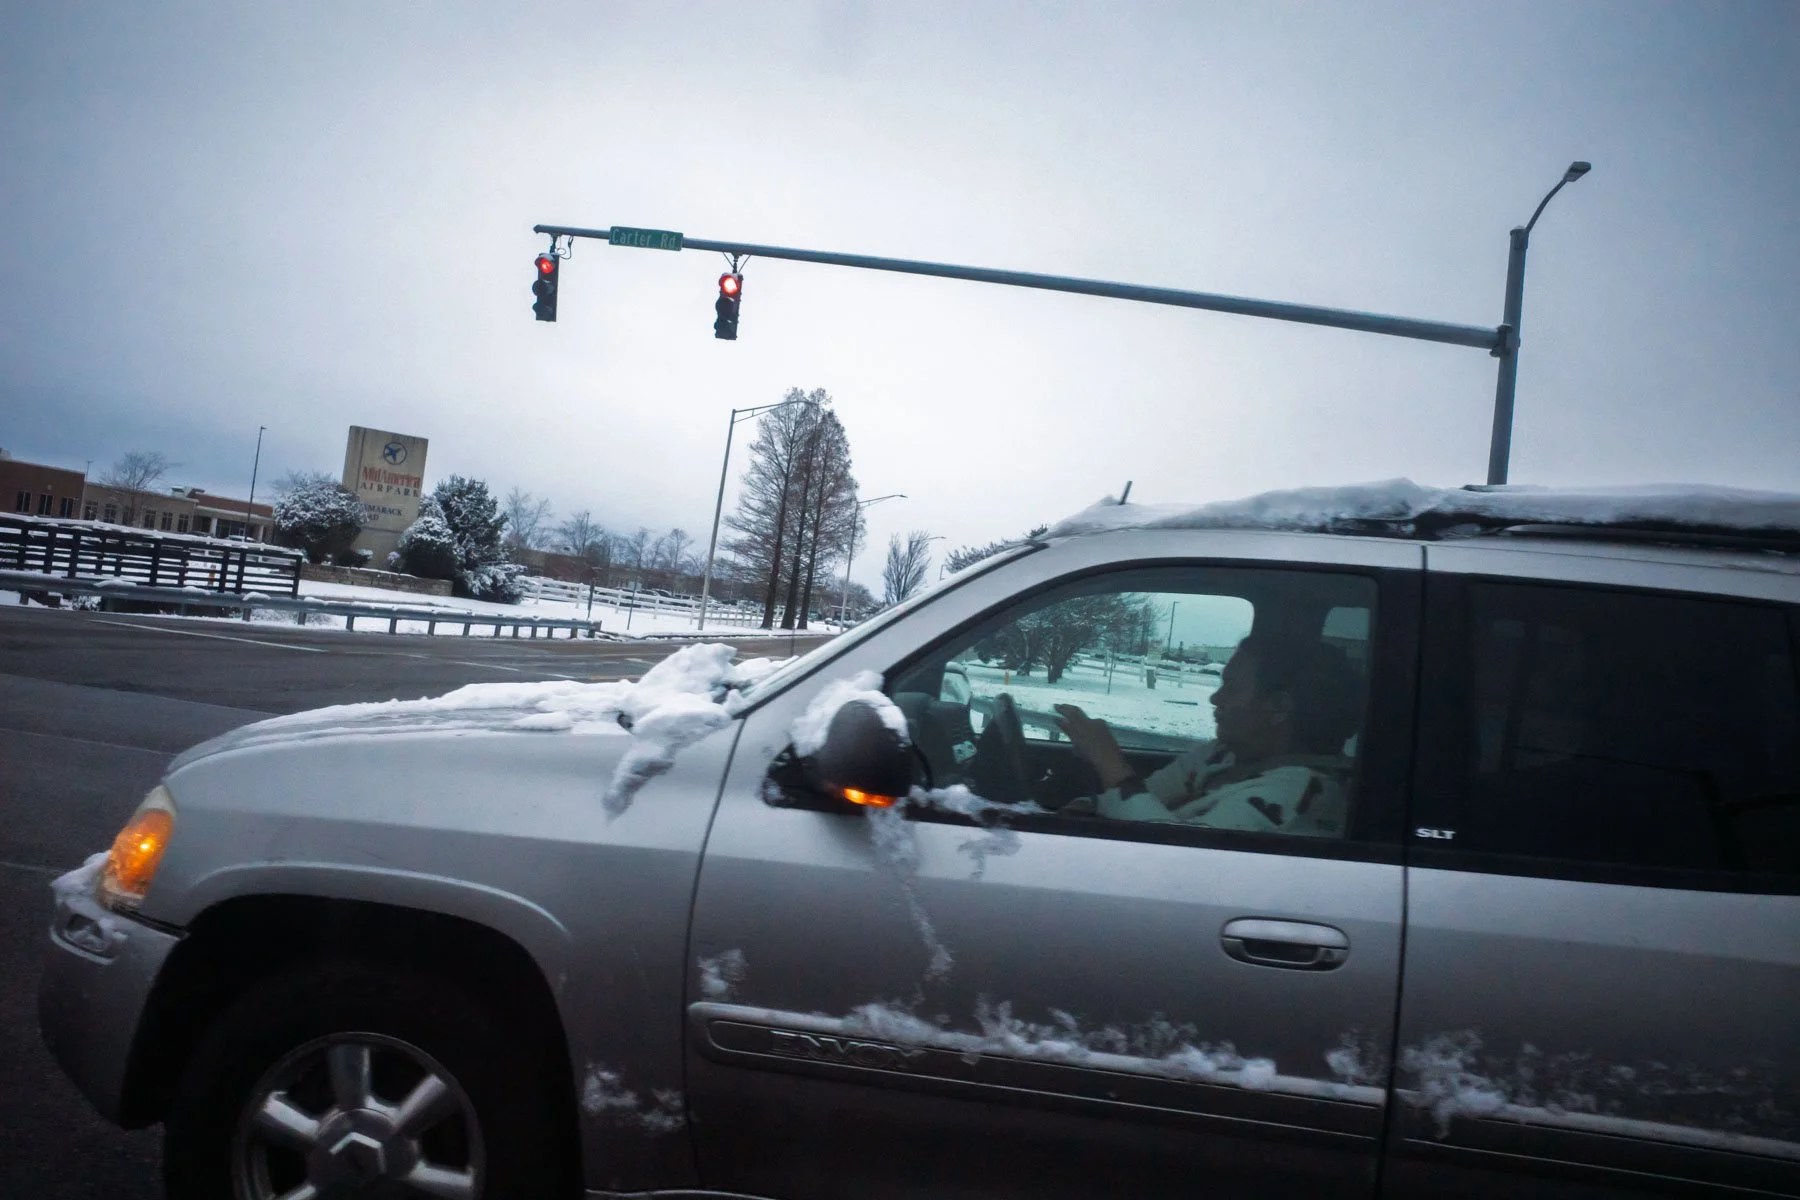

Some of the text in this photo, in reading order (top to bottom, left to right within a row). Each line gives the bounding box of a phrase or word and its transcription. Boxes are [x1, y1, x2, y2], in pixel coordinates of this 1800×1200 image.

[612, 228, 677, 249] Carter Rd
[360, 482, 420, 498] AIRPARK
[1415, 828, 1456, 840] SLT
[769, 1030, 927, 1069] ENVOY
